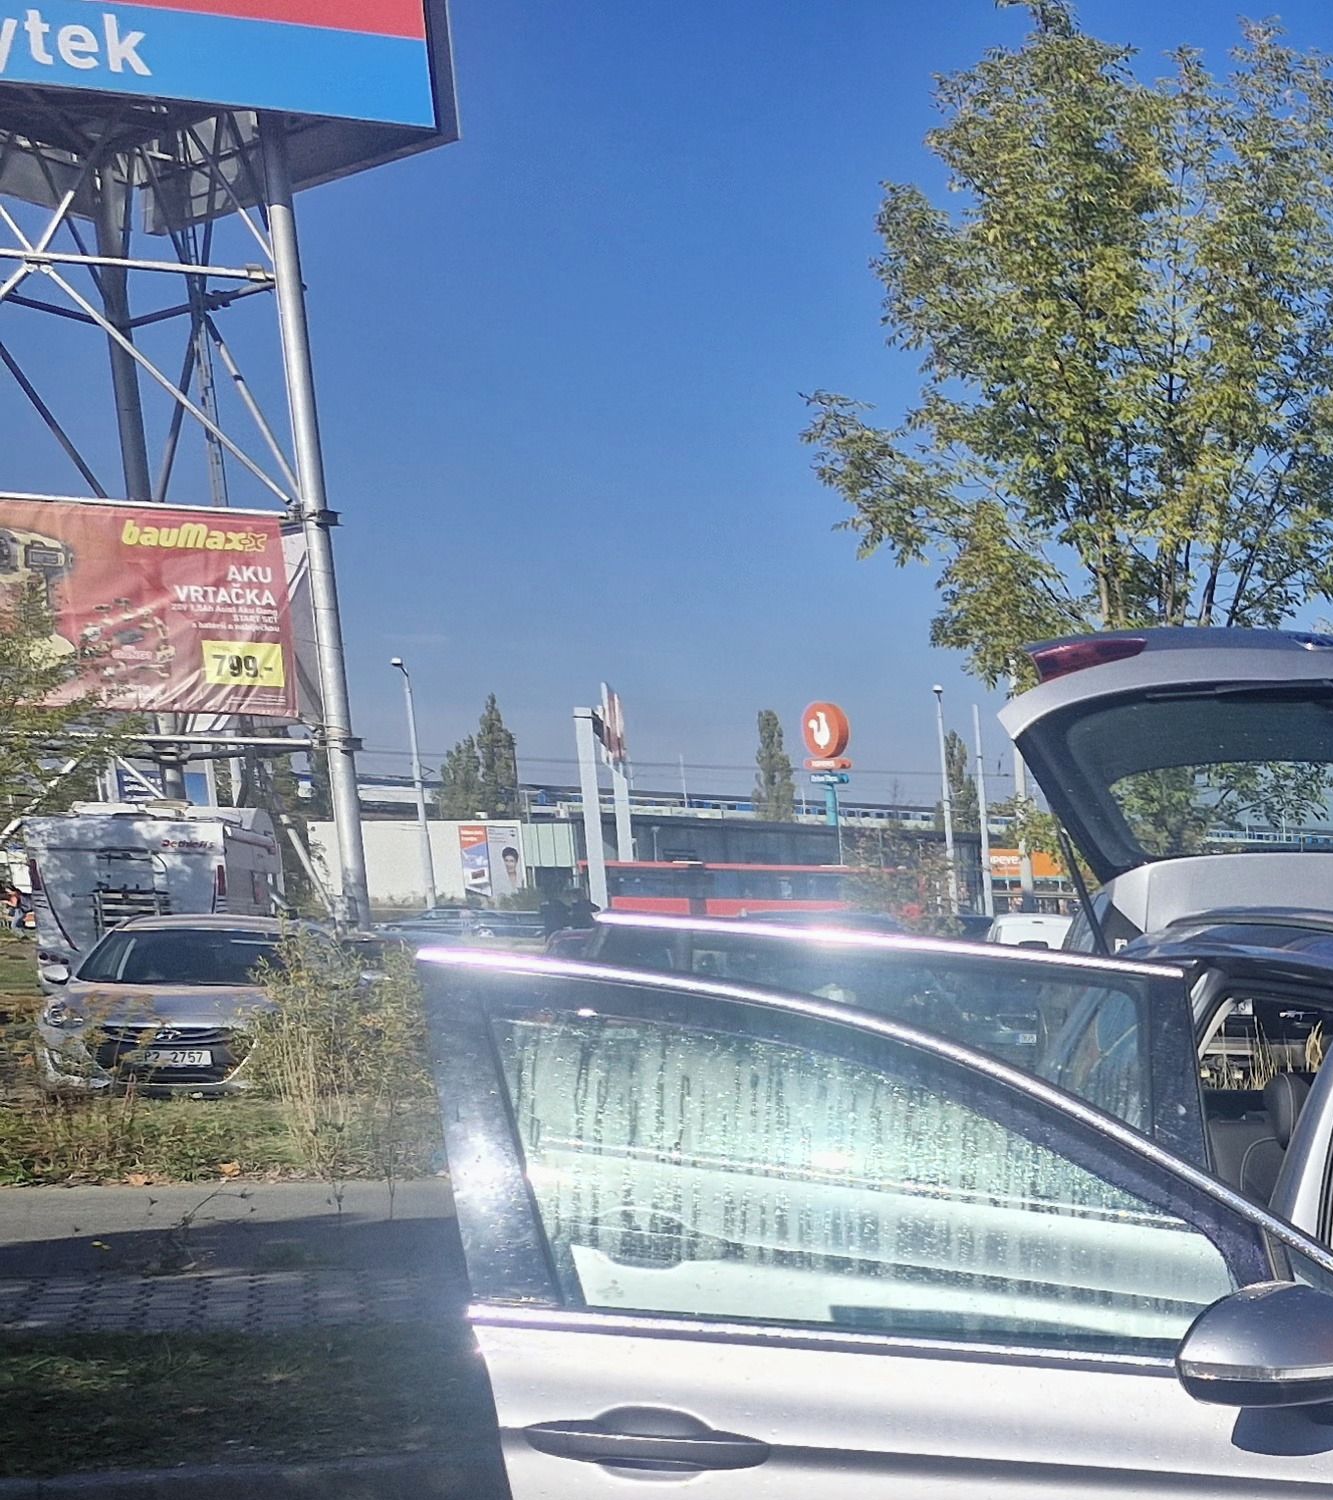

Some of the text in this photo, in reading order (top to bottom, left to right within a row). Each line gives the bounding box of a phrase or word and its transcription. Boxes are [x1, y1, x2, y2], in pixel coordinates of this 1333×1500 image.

[226, 564, 272, 584] AKU
[173, 583, 277, 607] VRTAČKA
[170, 1051, 204, 1064] 2757
